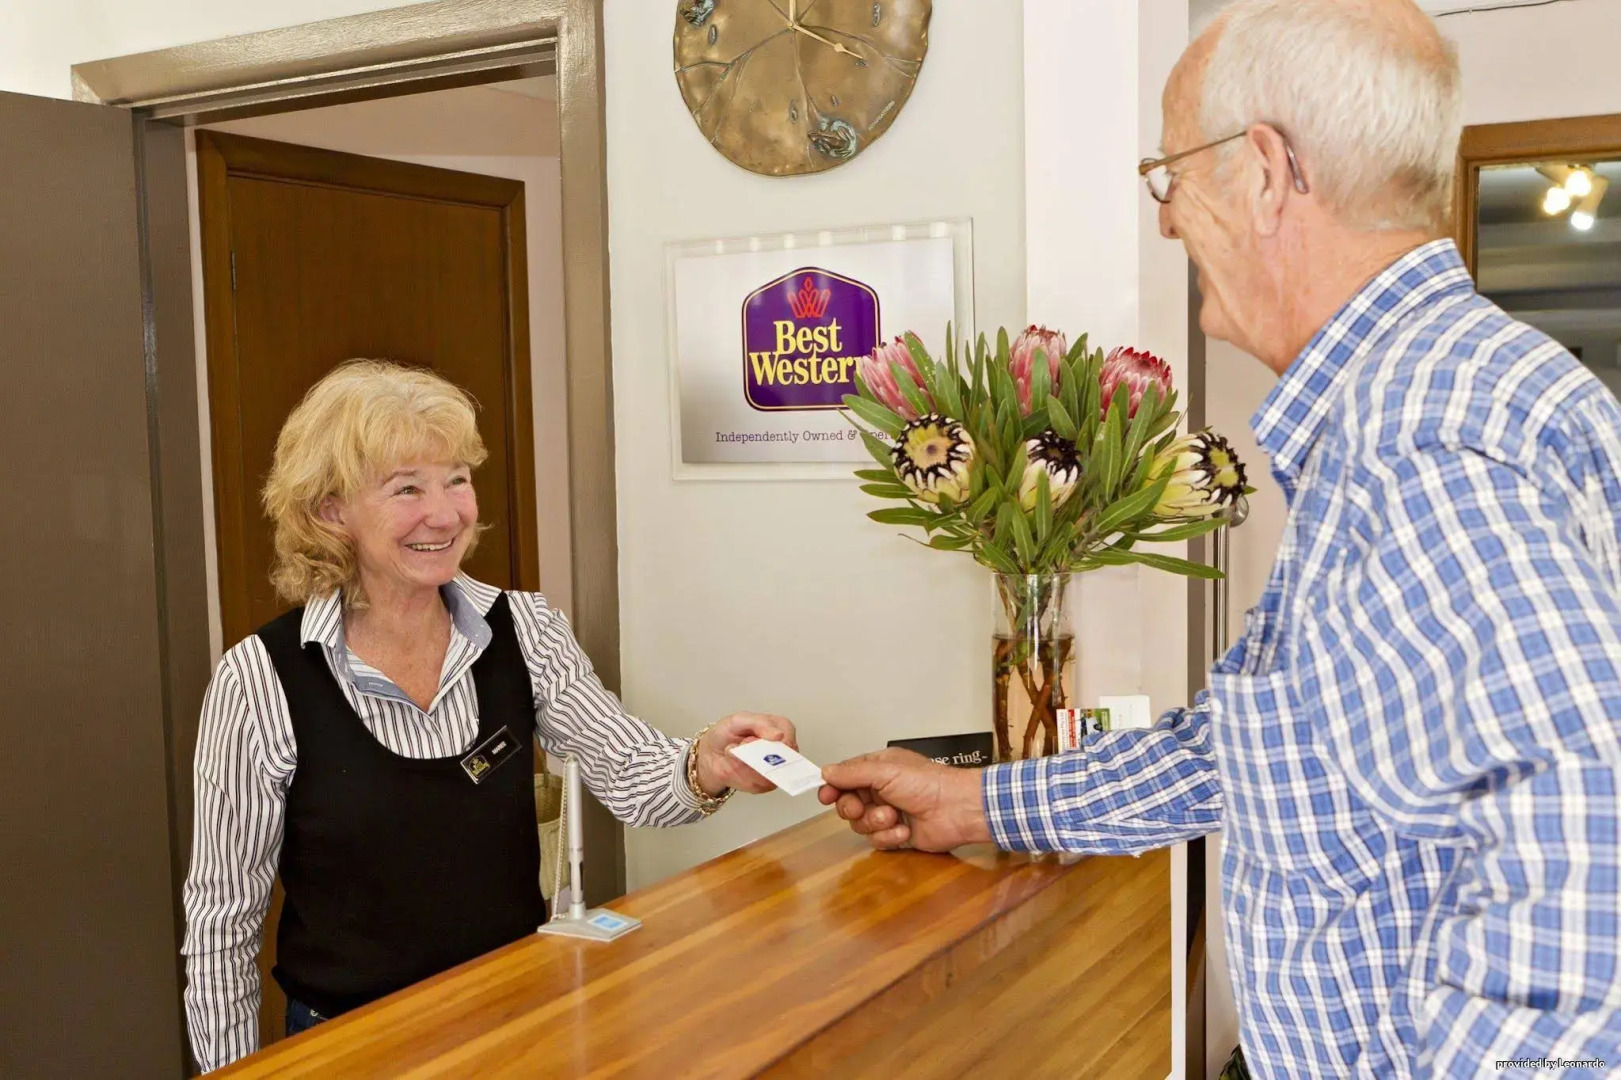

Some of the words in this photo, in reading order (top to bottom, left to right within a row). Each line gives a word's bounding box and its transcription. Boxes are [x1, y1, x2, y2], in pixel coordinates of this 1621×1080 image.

[773, 317, 843, 355] Best
[715, 430, 799, 444] Independently
[802, 430, 844, 441] Owned
[847, 429, 858, 441] &
